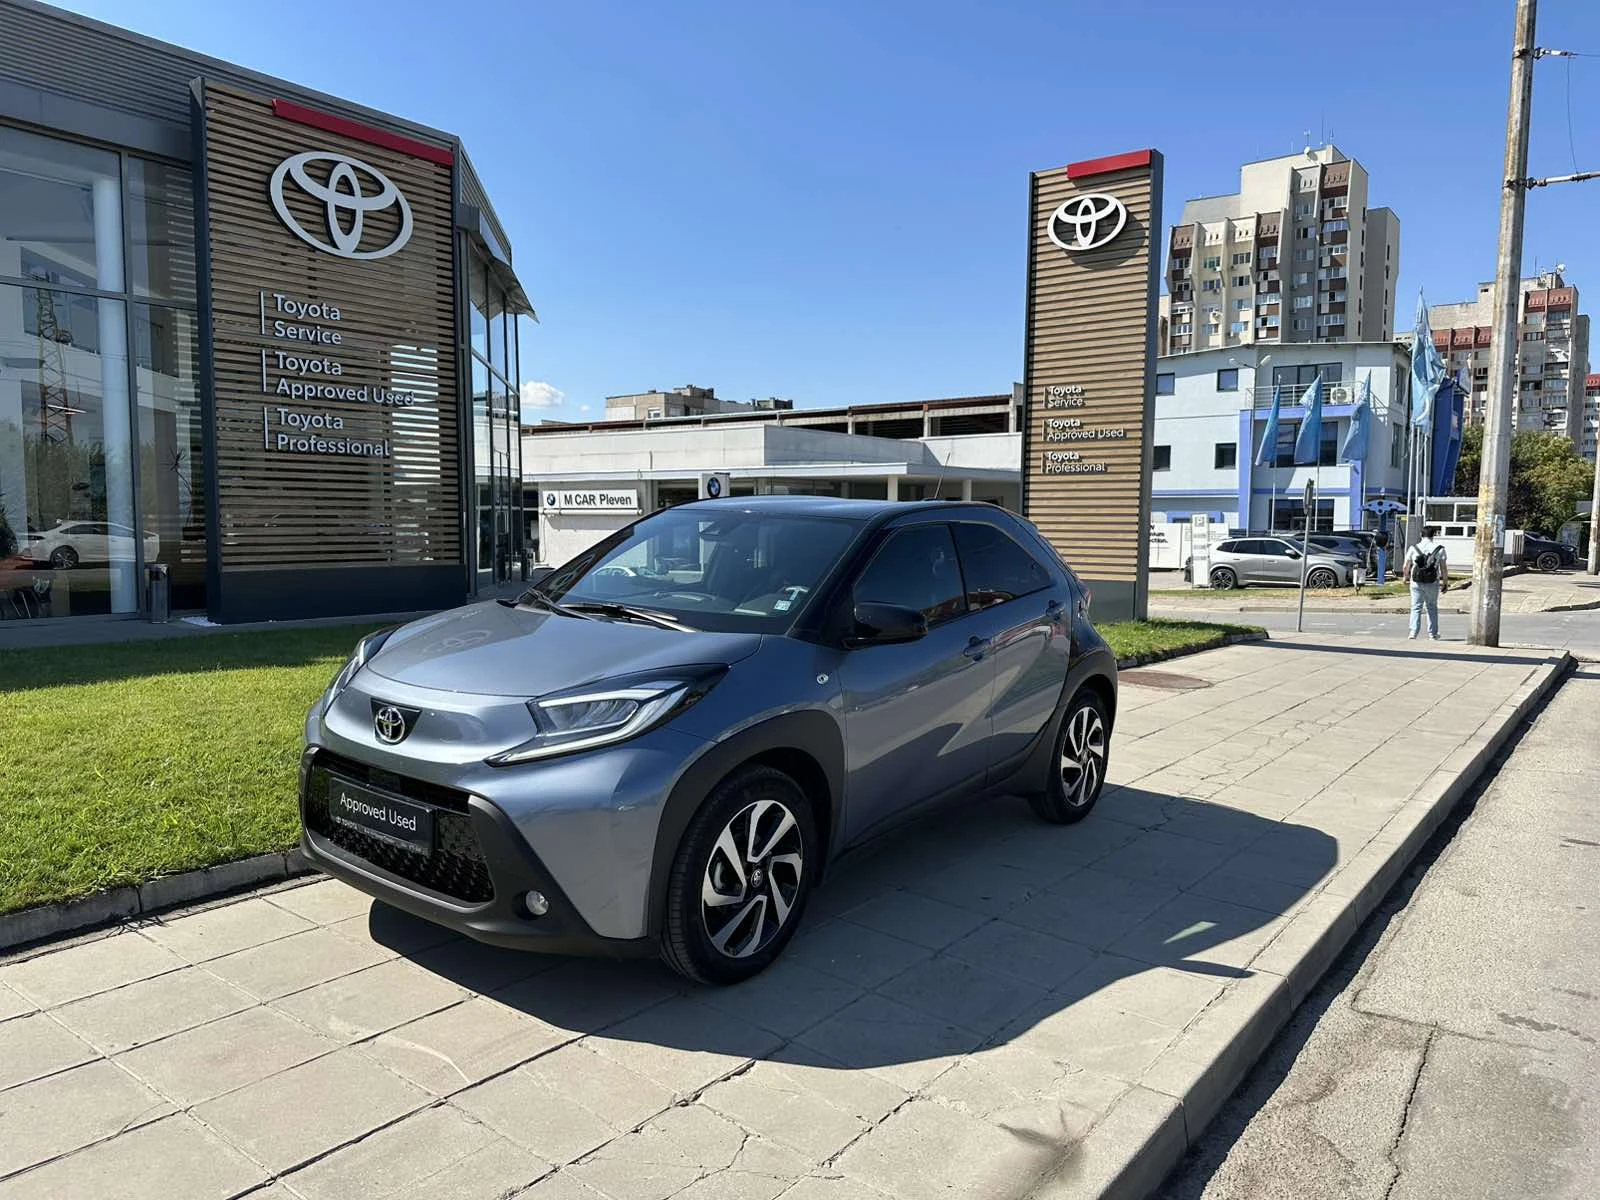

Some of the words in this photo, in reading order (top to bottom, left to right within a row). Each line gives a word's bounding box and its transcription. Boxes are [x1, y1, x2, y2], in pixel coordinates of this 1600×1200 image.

[273, 293, 341, 320] Toyota
[273, 320, 343, 345] Service
[274, 351, 343, 376] Toyota
[276, 378, 368, 402] Approved
[373, 388, 415, 406] Used
[1048, 385, 1082, 397] Toyota
[1047, 398, 1083, 408] Service
[276, 407, 344, 432] Toyota
[1047, 419, 1080, 430] Toyota
[1046, 430, 1095, 441] Approved
[1098, 428, 1124, 439] Used
[277, 434, 391, 456] Professional
[1047, 451, 1079, 463] Toyota
[1045, 462, 1105, 473] Professional
[564, 495, 573, 505] M
[575, 494, 597, 505] CAR
[599, 494, 632, 505] Pleven
[340, 792, 386, 821] Approved
[388, 809, 416, 831] Used
